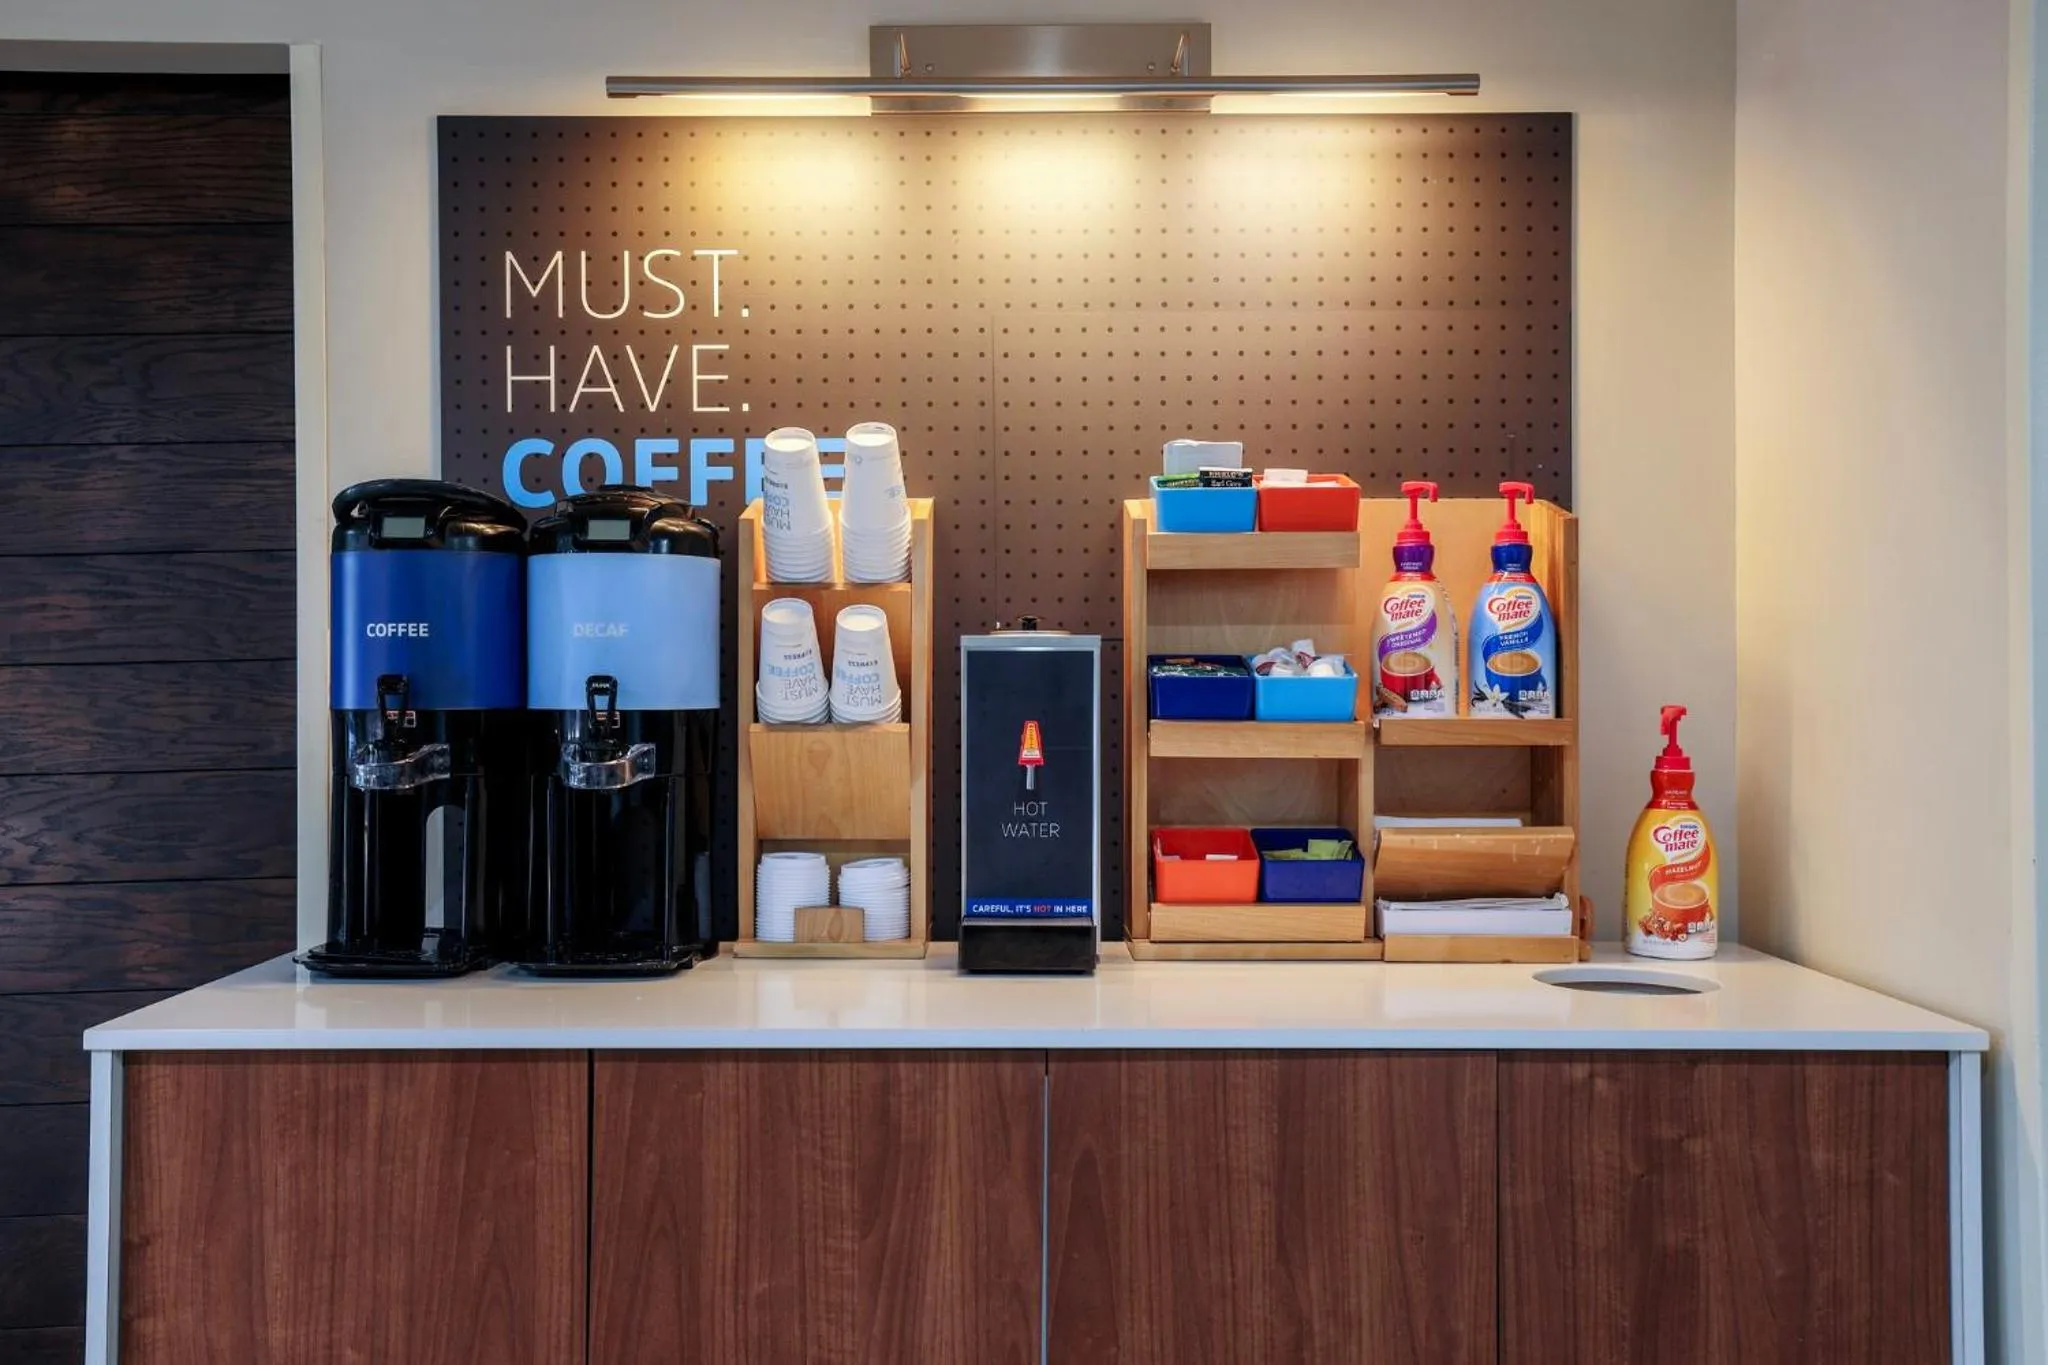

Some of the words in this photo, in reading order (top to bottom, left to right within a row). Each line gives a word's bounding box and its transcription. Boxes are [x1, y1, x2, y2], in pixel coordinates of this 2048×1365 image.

[505, 249, 749, 319] MUST.
[506, 344, 749, 413] HAVE.
[1384, 596, 1425, 615] Coffee
[1488, 597, 1532, 615] Coffee
[1390, 608, 1423, 622] mate
[1498, 609, 1530, 622] mate
[366, 622, 429, 638] COFFEE
[573, 622, 628, 638] DECAF
[1013, 801, 1048, 817] HOT
[1001, 822, 1060, 838] WATER
[1653, 825, 1699, 844] Coffee
[1664, 840, 1697, 853] mate
[972, 904, 1013, 914] CAREFUL,
[1015, 904, 1032, 913] IT'S
[1033, 905, 1051, 913] HOT
[1053, 905, 1063, 913] IN
[1065, 905, 1088, 913] HERE
